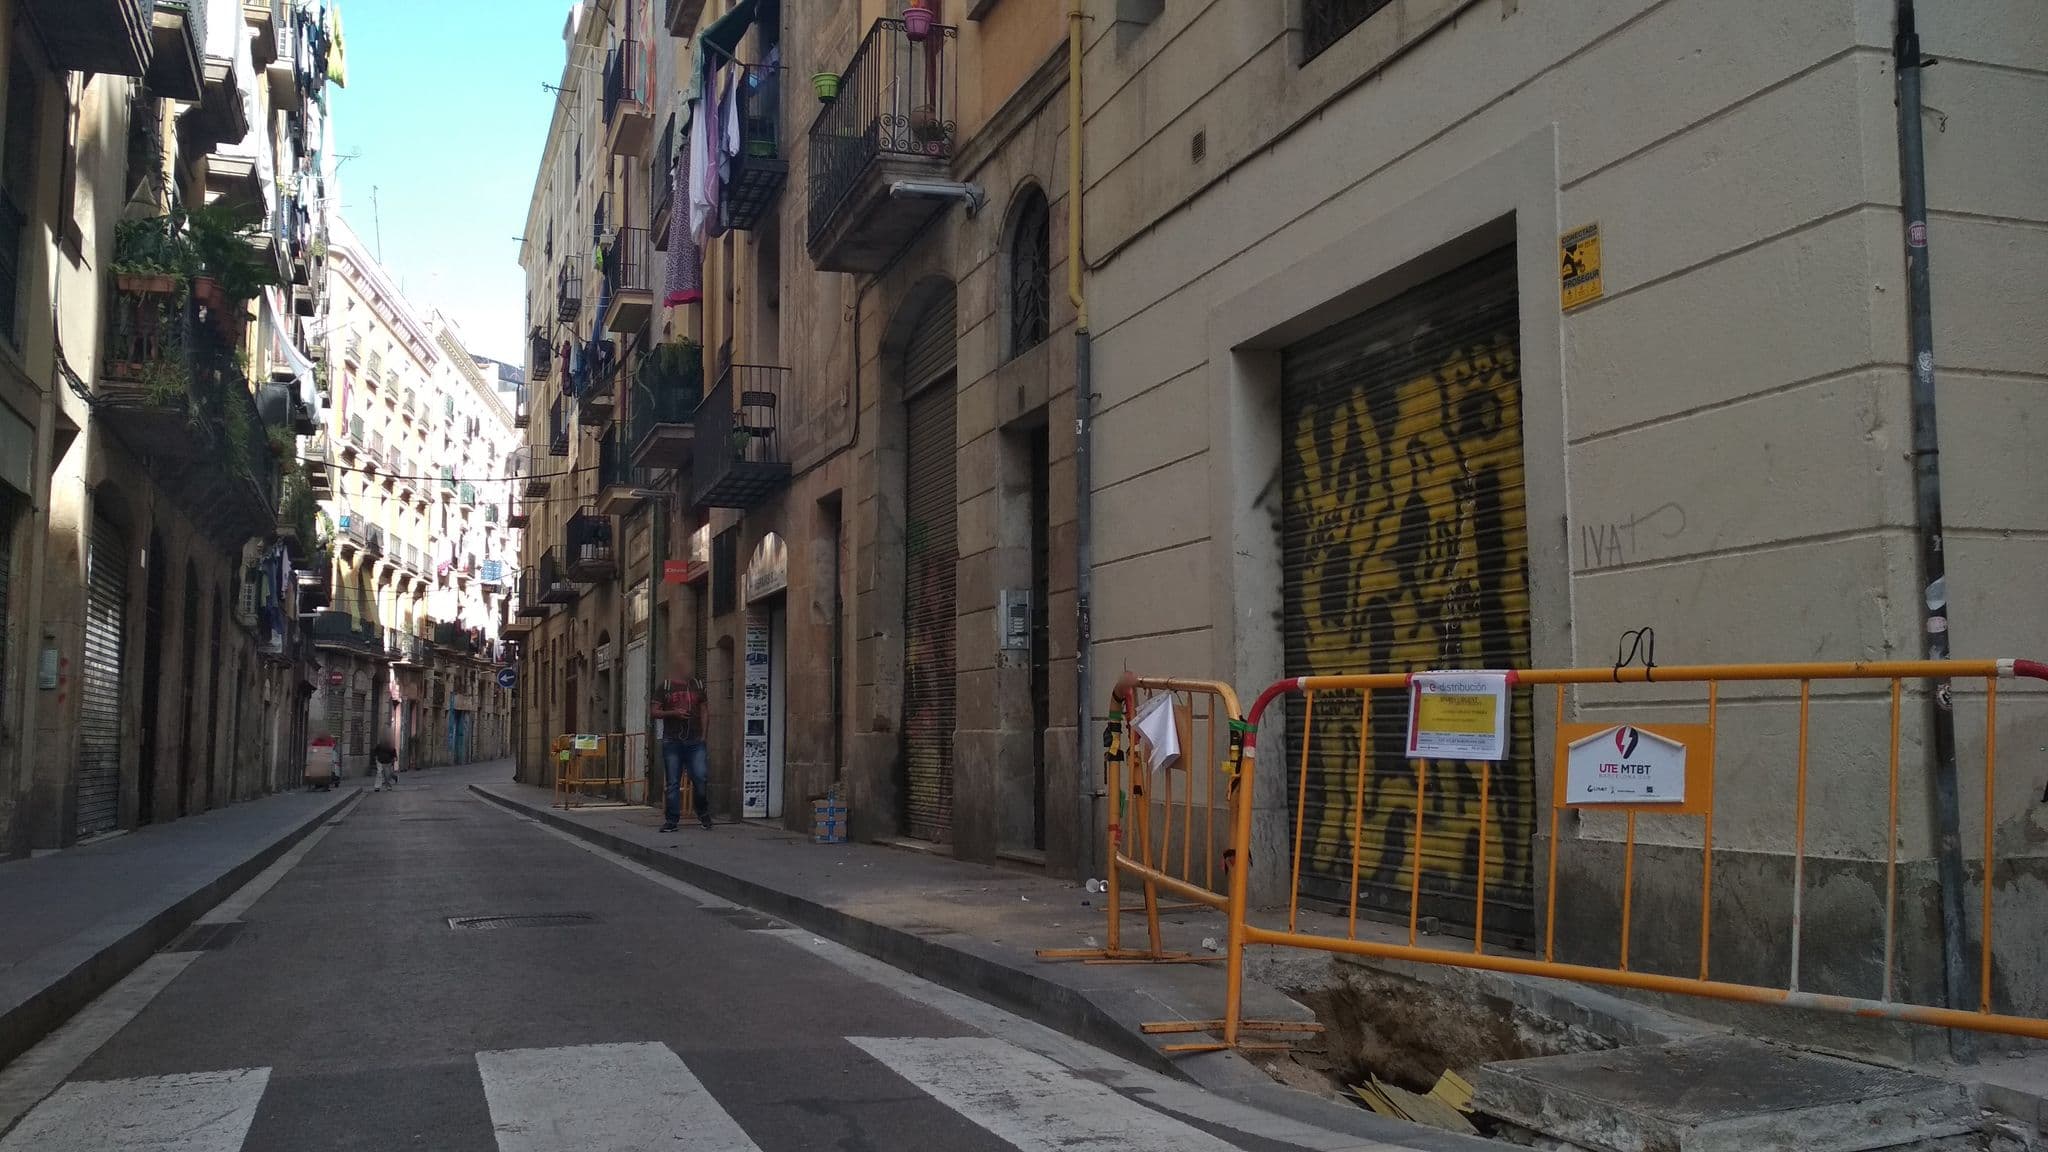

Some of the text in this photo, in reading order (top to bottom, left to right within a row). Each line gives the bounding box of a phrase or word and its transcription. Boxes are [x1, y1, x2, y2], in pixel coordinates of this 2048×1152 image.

[1563, 269, 1600, 290] PROSEGUR
[1599, 763, 1652, 775] UTE MTBT
